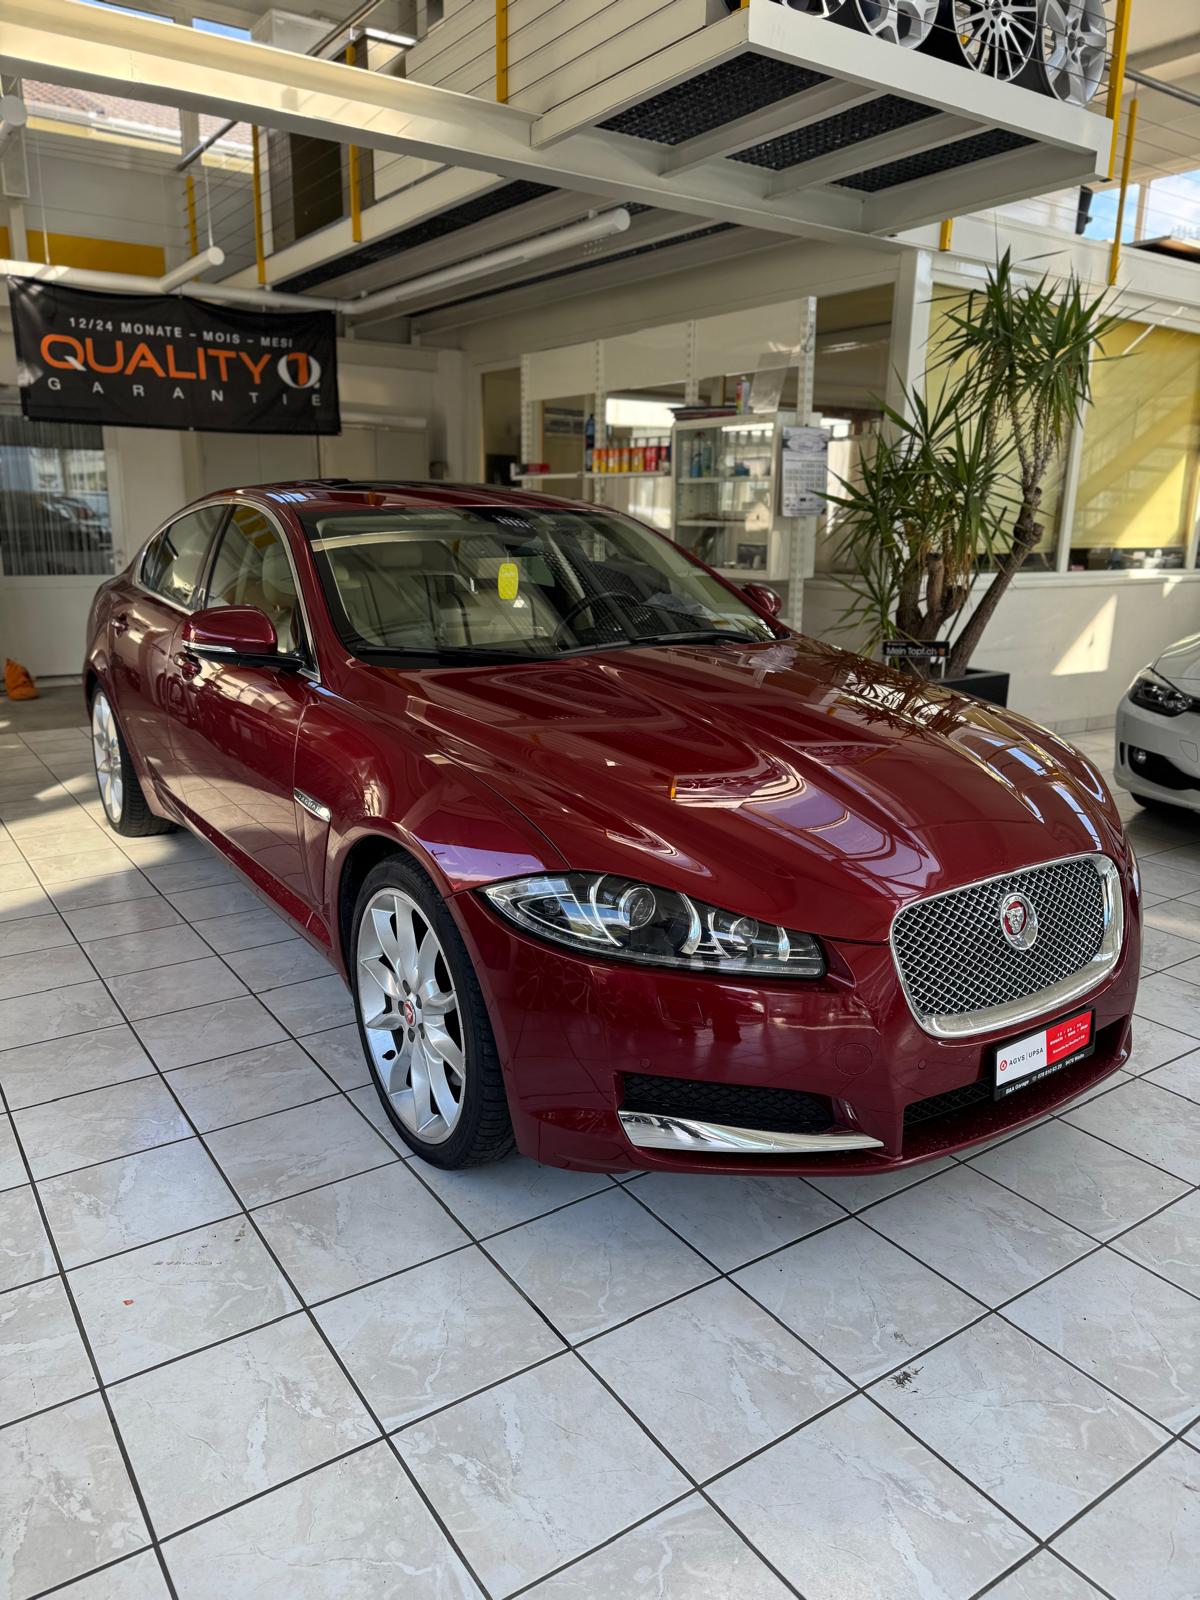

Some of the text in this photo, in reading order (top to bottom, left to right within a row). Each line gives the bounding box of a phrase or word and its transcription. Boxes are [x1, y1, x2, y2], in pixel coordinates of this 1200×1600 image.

[69, 316, 113, 332] 12/24
[120, 322, 183, 338] MONATE
[202, 331, 240, 345] MOIS
[260, 336, 293, 348] MESI
[40, 333, 271, 385] QUALITY
[47, 377, 321, 407] GARANTIE
[886, 647, 937, 656] Mein Topf.ch
[1009, 1047, 1044, 1066] AGVS UPSA
